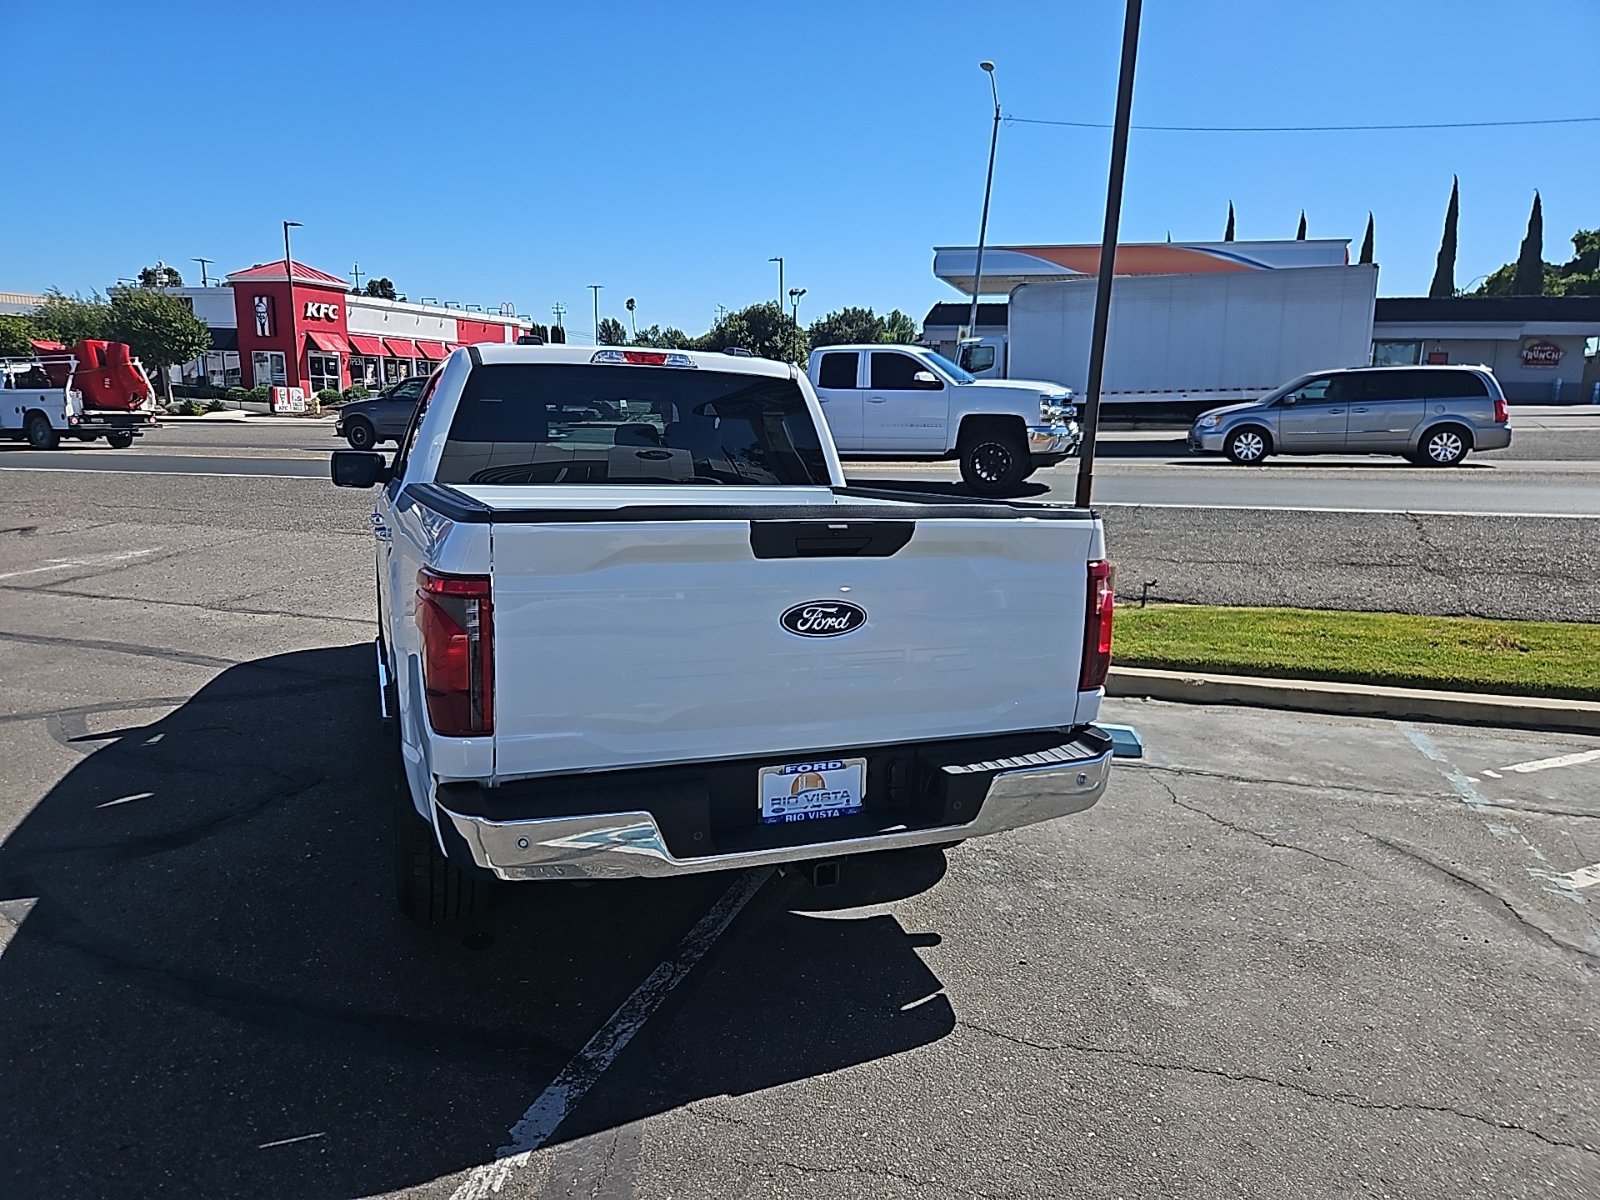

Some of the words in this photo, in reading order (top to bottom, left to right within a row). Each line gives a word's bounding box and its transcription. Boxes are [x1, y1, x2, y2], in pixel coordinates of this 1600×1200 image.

[305, 301, 339, 320] KFC
[796, 607, 852, 631] Ford
[785, 762, 842, 774] FORD
[804, 790, 851, 803] VISTA
[785, 813, 805, 822] RIO
[808, 809, 840, 820] VISTA
